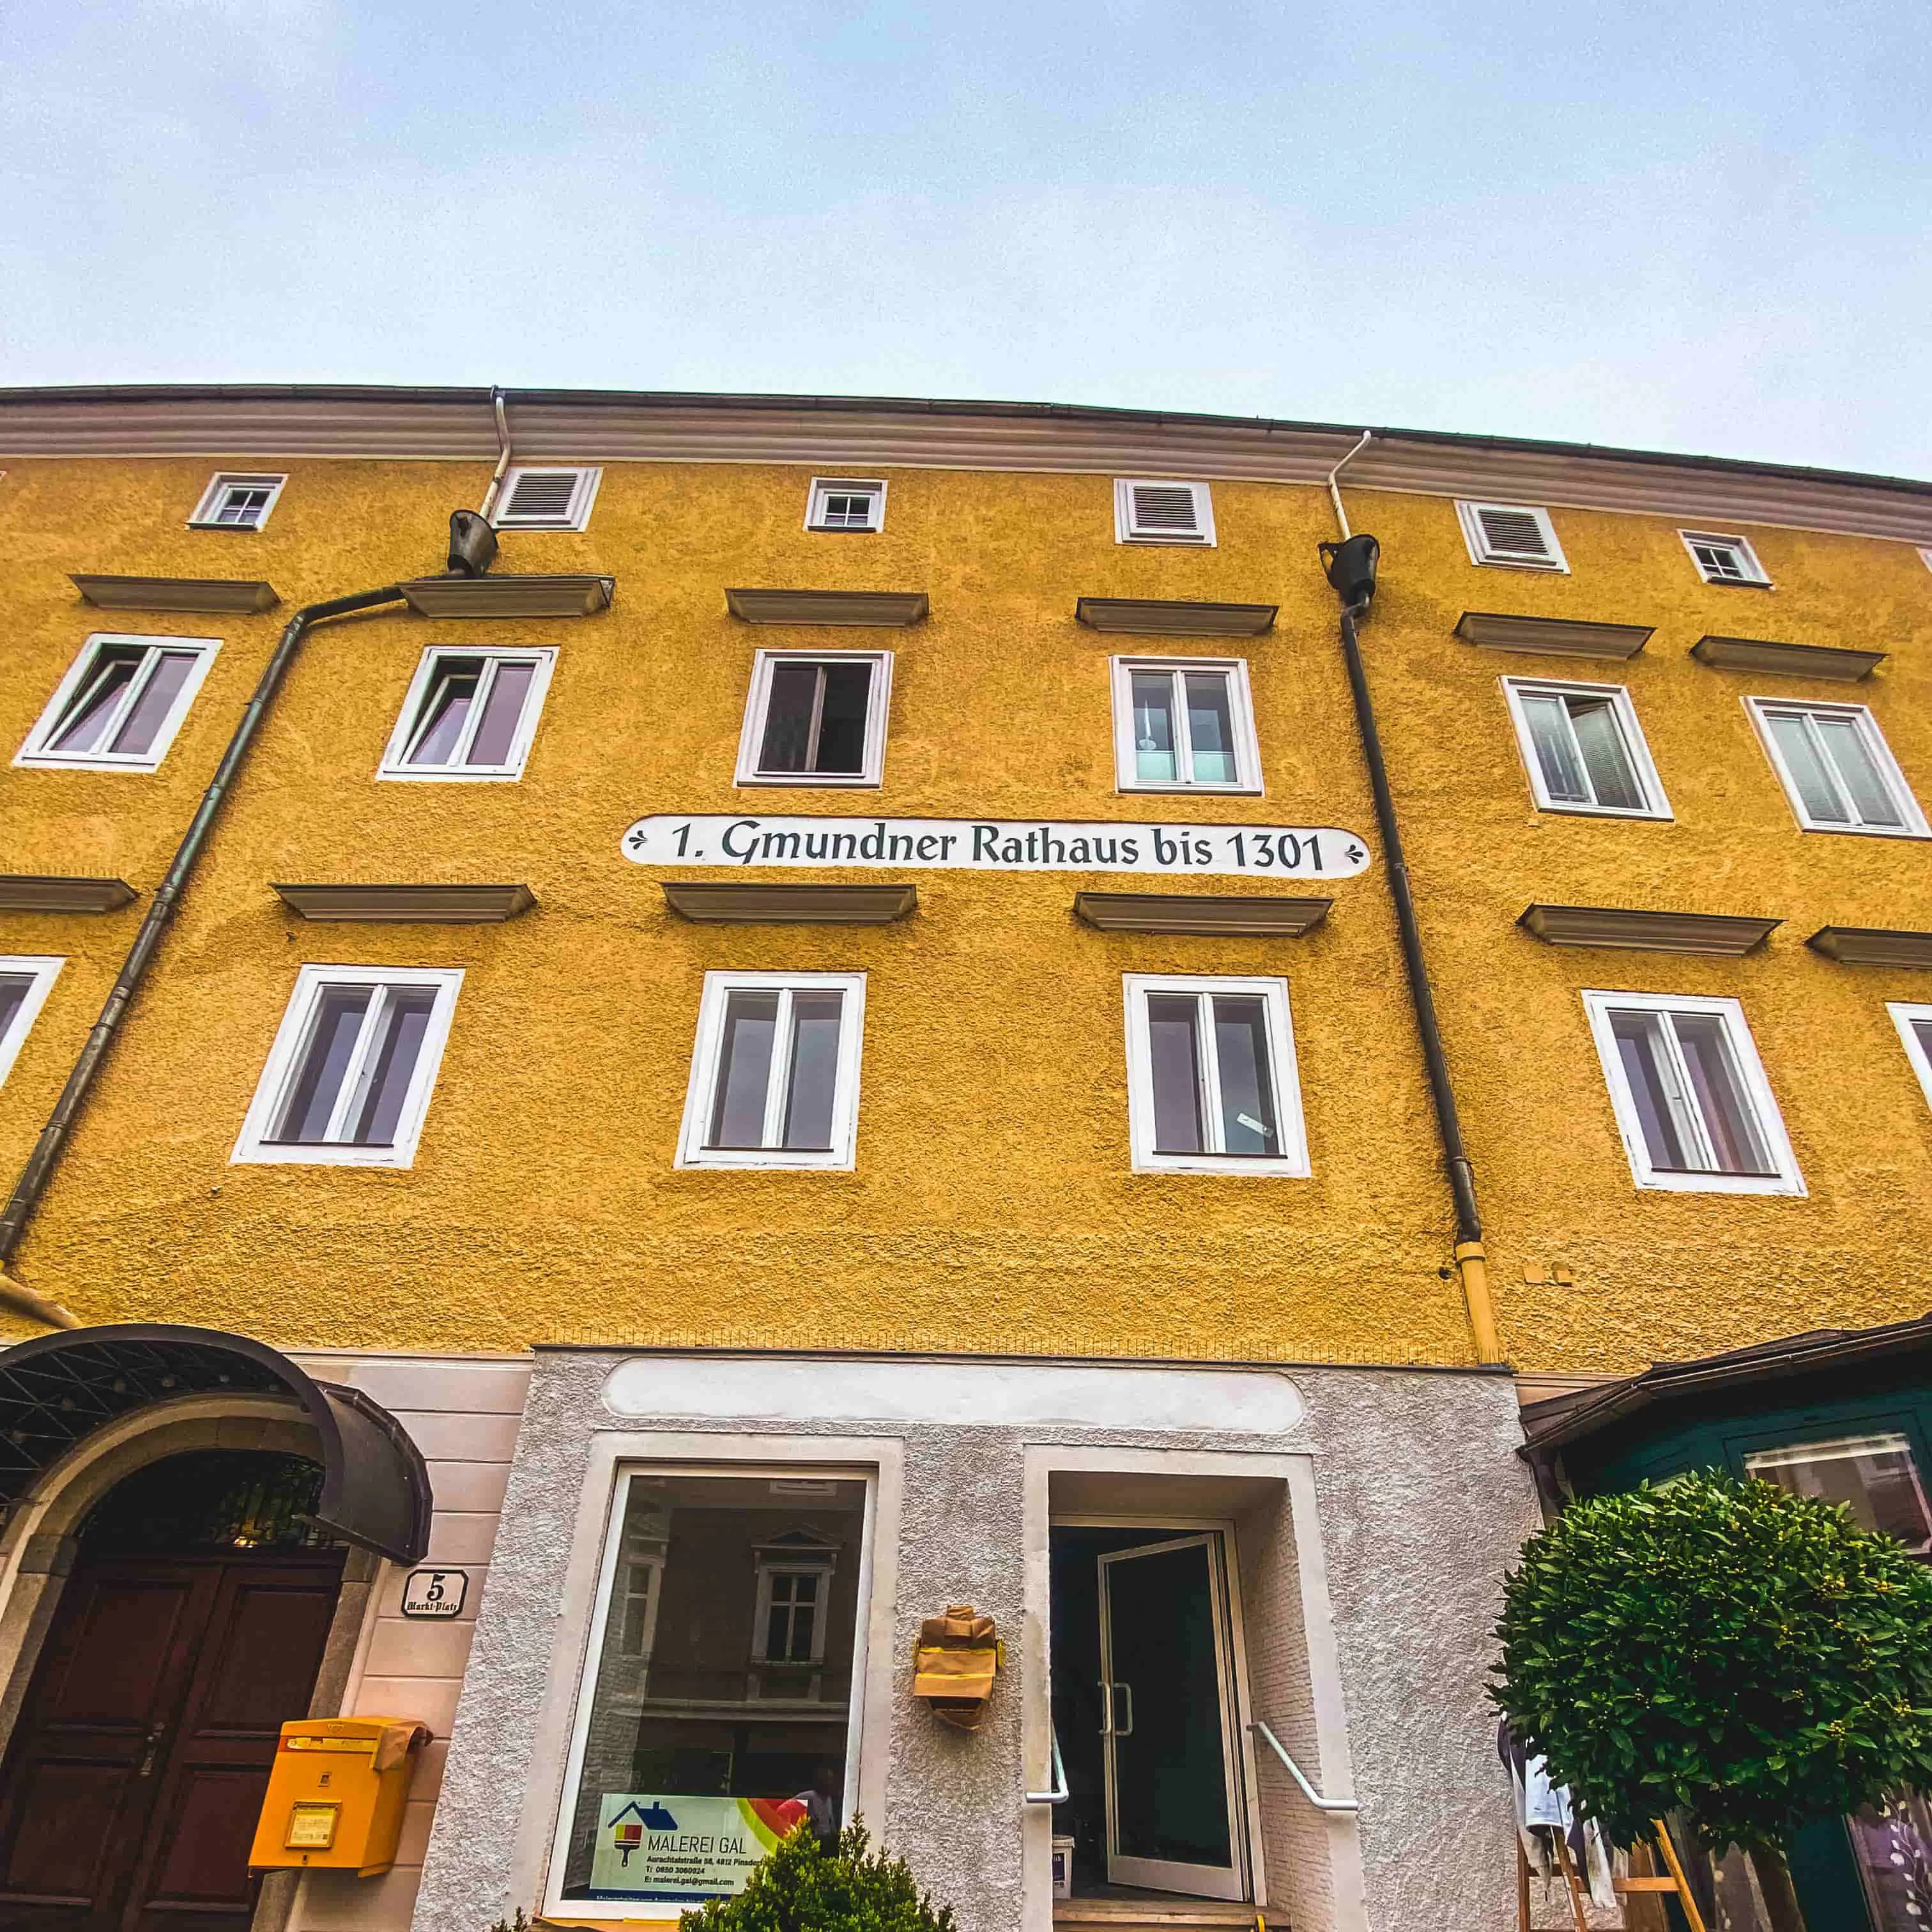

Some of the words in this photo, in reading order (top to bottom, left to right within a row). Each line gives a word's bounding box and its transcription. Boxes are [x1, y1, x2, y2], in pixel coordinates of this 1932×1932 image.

[672, 824, 703, 857] 1.
[722, 820, 956, 865] Gmundner
[971, 825, 1138, 864] Rathaus
[1151, 828, 1213, 865] bis
[1226, 832, 1322, 871] 1301
[426, 1574, 445, 1601] 5
[648, 1834, 714, 1853] MALEREI
[719, 1837, 747, 1854] GAL
